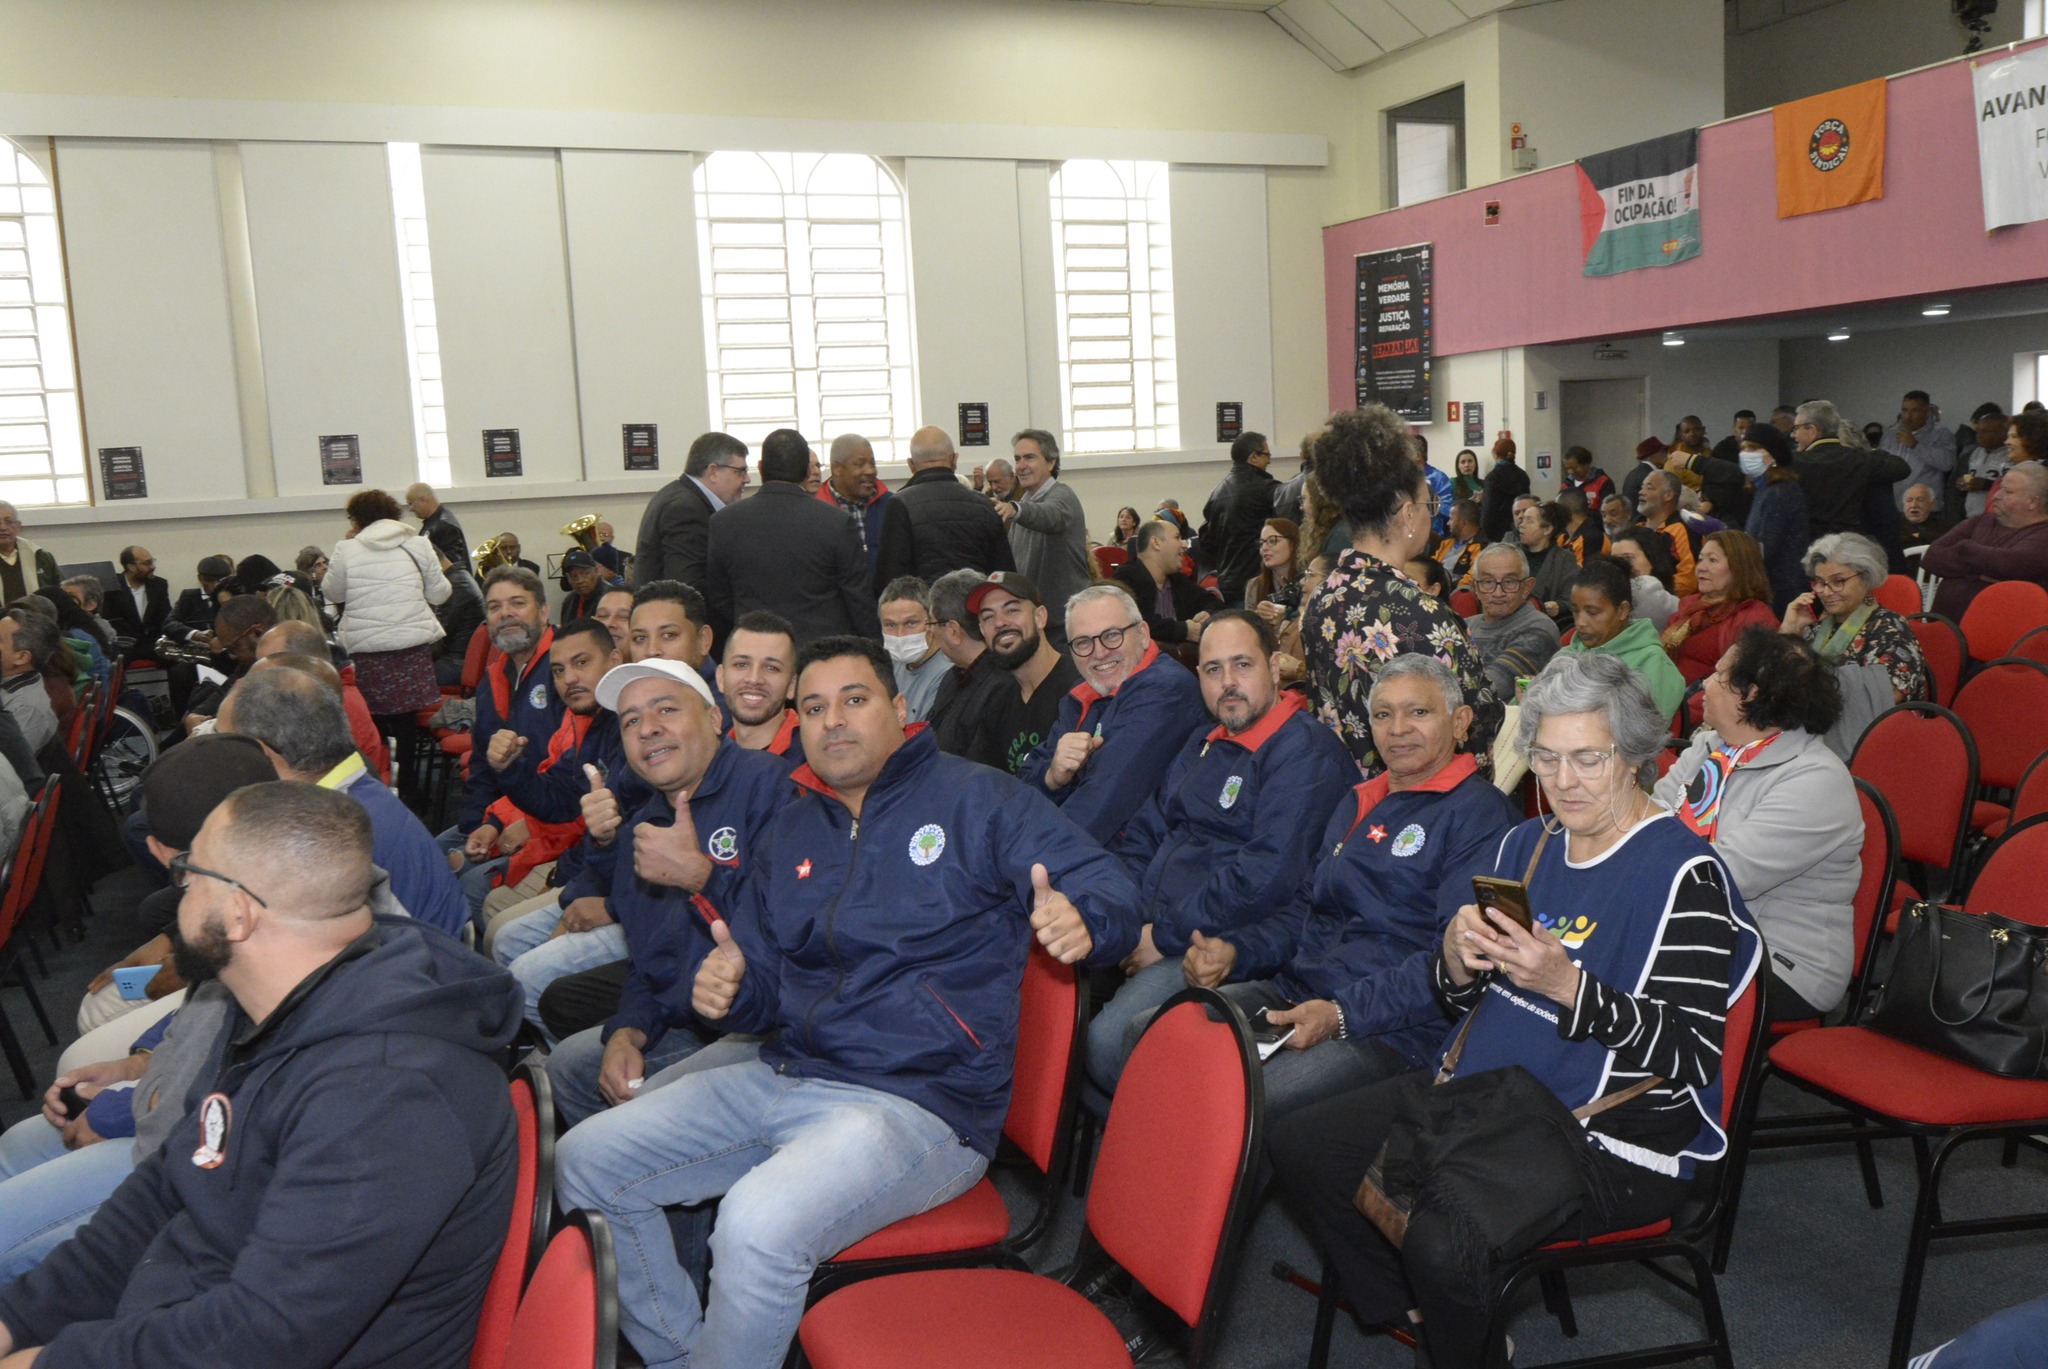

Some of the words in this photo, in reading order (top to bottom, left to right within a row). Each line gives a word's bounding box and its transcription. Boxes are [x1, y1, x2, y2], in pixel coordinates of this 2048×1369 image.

[1982, 85, 2048, 122] AVAN
[1814, 121, 1845, 138] FORÇA
[2036, 128, 2048, 148] F
[1810, 145, 1848, 170] SINDICAL
[1638, 182, 1655, 200] DA
[1614, 196, 1677, 224] OCUPAÇÃO!
[1377, 280, 1410, 293] MEMÓRIA
[1378, 292, 1410, 304] VERDADE
[1378, 309, 1410, 322] JUSTIÇA
